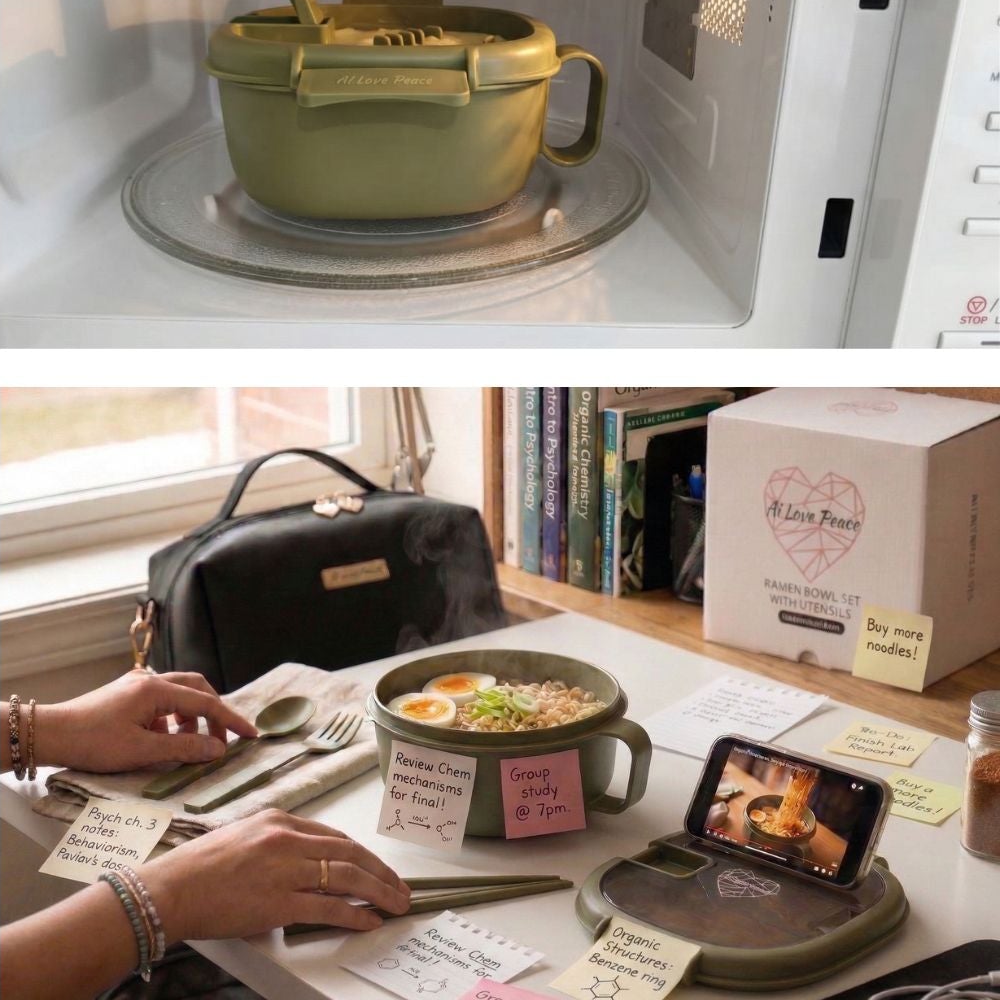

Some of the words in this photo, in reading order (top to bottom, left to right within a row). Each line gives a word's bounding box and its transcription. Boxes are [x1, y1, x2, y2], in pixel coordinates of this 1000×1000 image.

[356, 75, 388, 85] Love
[393, 75, 433, 85] Peace
[960, 316, 988, 324] STOP
[525, 415, 536, 429] to
[546, 420, 557, 434] to
[579, 390, 592, 446] Organic
[525, 432, 538, 512] Psychology
[545, 438, 559, 520] Psychology
[578, 450, 592, 520] Chemistry
[785, 503, 816, 523] Love
[818, 509, 862, 532] Peace
[764, 578, 802, 595] RAMEN
[804, 587, 839, 602] BOWL
[842, 592, 862, 607] SET
[769, 593, 797, 609] WITH
[800, 601, 852, 619] UTENSILS
[867, 617, 889, 638] Buy
[894, 627, 924, 642] more
[866, 641, 918, 661] noodles!
[845, 734, 885, 747] Finish
[395, 751, 435, 773] Review
[438, 762, 472, 781] Chem
[510, 767, 550, 782] Group
[392, 771, 464, 797] mechanisms
[521, 785, 559, 799] study
[895, 778, 925, 790] Buy
[389, 786, 408, 802] for
[411, 792, 446, 812] final!
[88, 806, 122, 825] Psych
[125, 815, 143, 828] ch.
[146, 818, 157, 831] 3
[515, 804, 530, 822] @
[80, 824, 119, 838] notes:
[66, 833, 140, 860] Behaviorism,
[424, 928, 467, 953] Review
[468, 950, 502, 970] Chem
[612, 926, 661, 951] Organic
[408, 937, 471, 970] mechanisms
[472, 967, 493, 978] for
[588, 952, 639, 978] Benzene
[640, 972, 667, 991] ring
